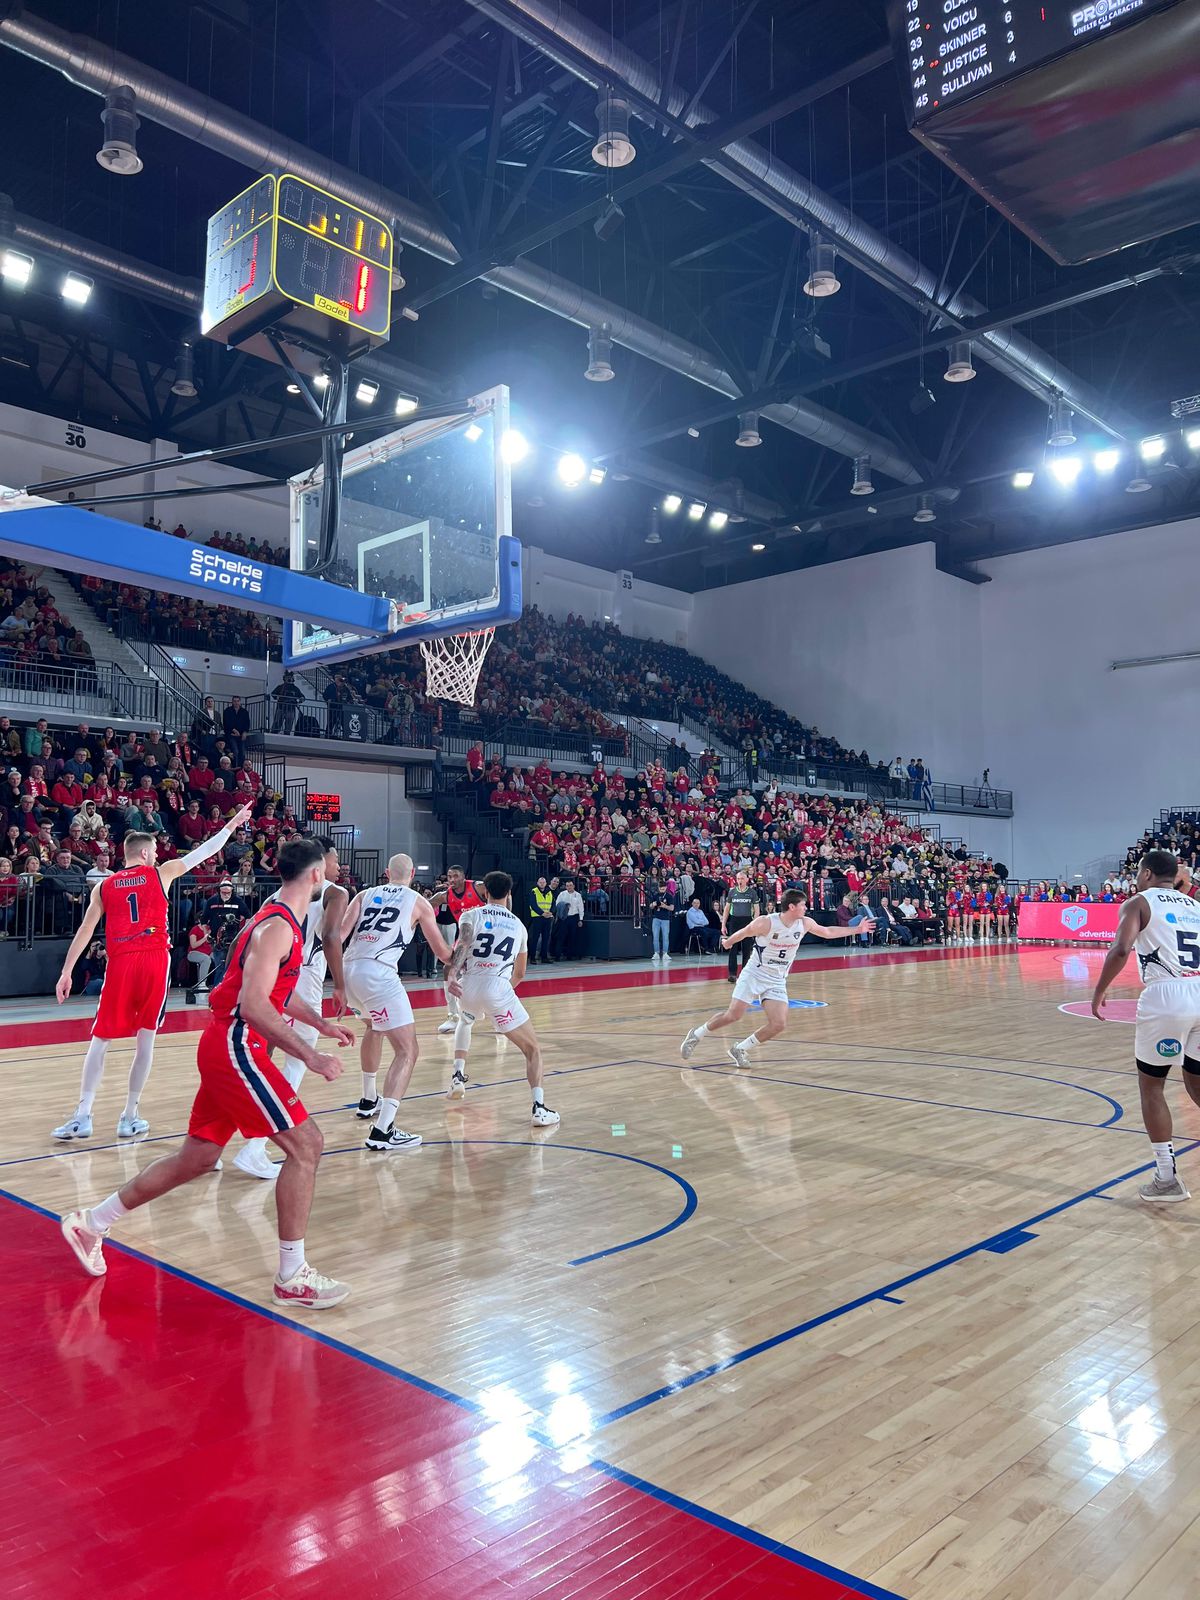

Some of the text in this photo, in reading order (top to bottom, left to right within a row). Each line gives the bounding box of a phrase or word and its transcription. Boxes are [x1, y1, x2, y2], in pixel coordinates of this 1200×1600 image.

[907, 0, 918, 13] 19
[908, 17, 920, 33] 22
[910, 7, 977, 52] 33 VOICU
[1073, 21, 1098, 37] UNELTE
[1097, 15, 1108, 25] CU
[911, 10, 1012, 71] 34 SKINNER 6
[914, 30, 1014, 89] 44 JUSTICE 3
[916, 50, 1016, 108] 45 SULLIVAN 4
[65, 432, 86, 449] 30
[189, 562, 262, 593] Sports
[191, 549, 263, 580] Schelde
[622, 579, 632, 590] 33
[591, 750, 602, 762] 10
[126, 892, 139, 923] 1
[357, 906, 400, 933] 22
[473, 933, 515, 962] 34
[778, 949, 787, 959] 6
[1176, 930, 1200, 969] 5
